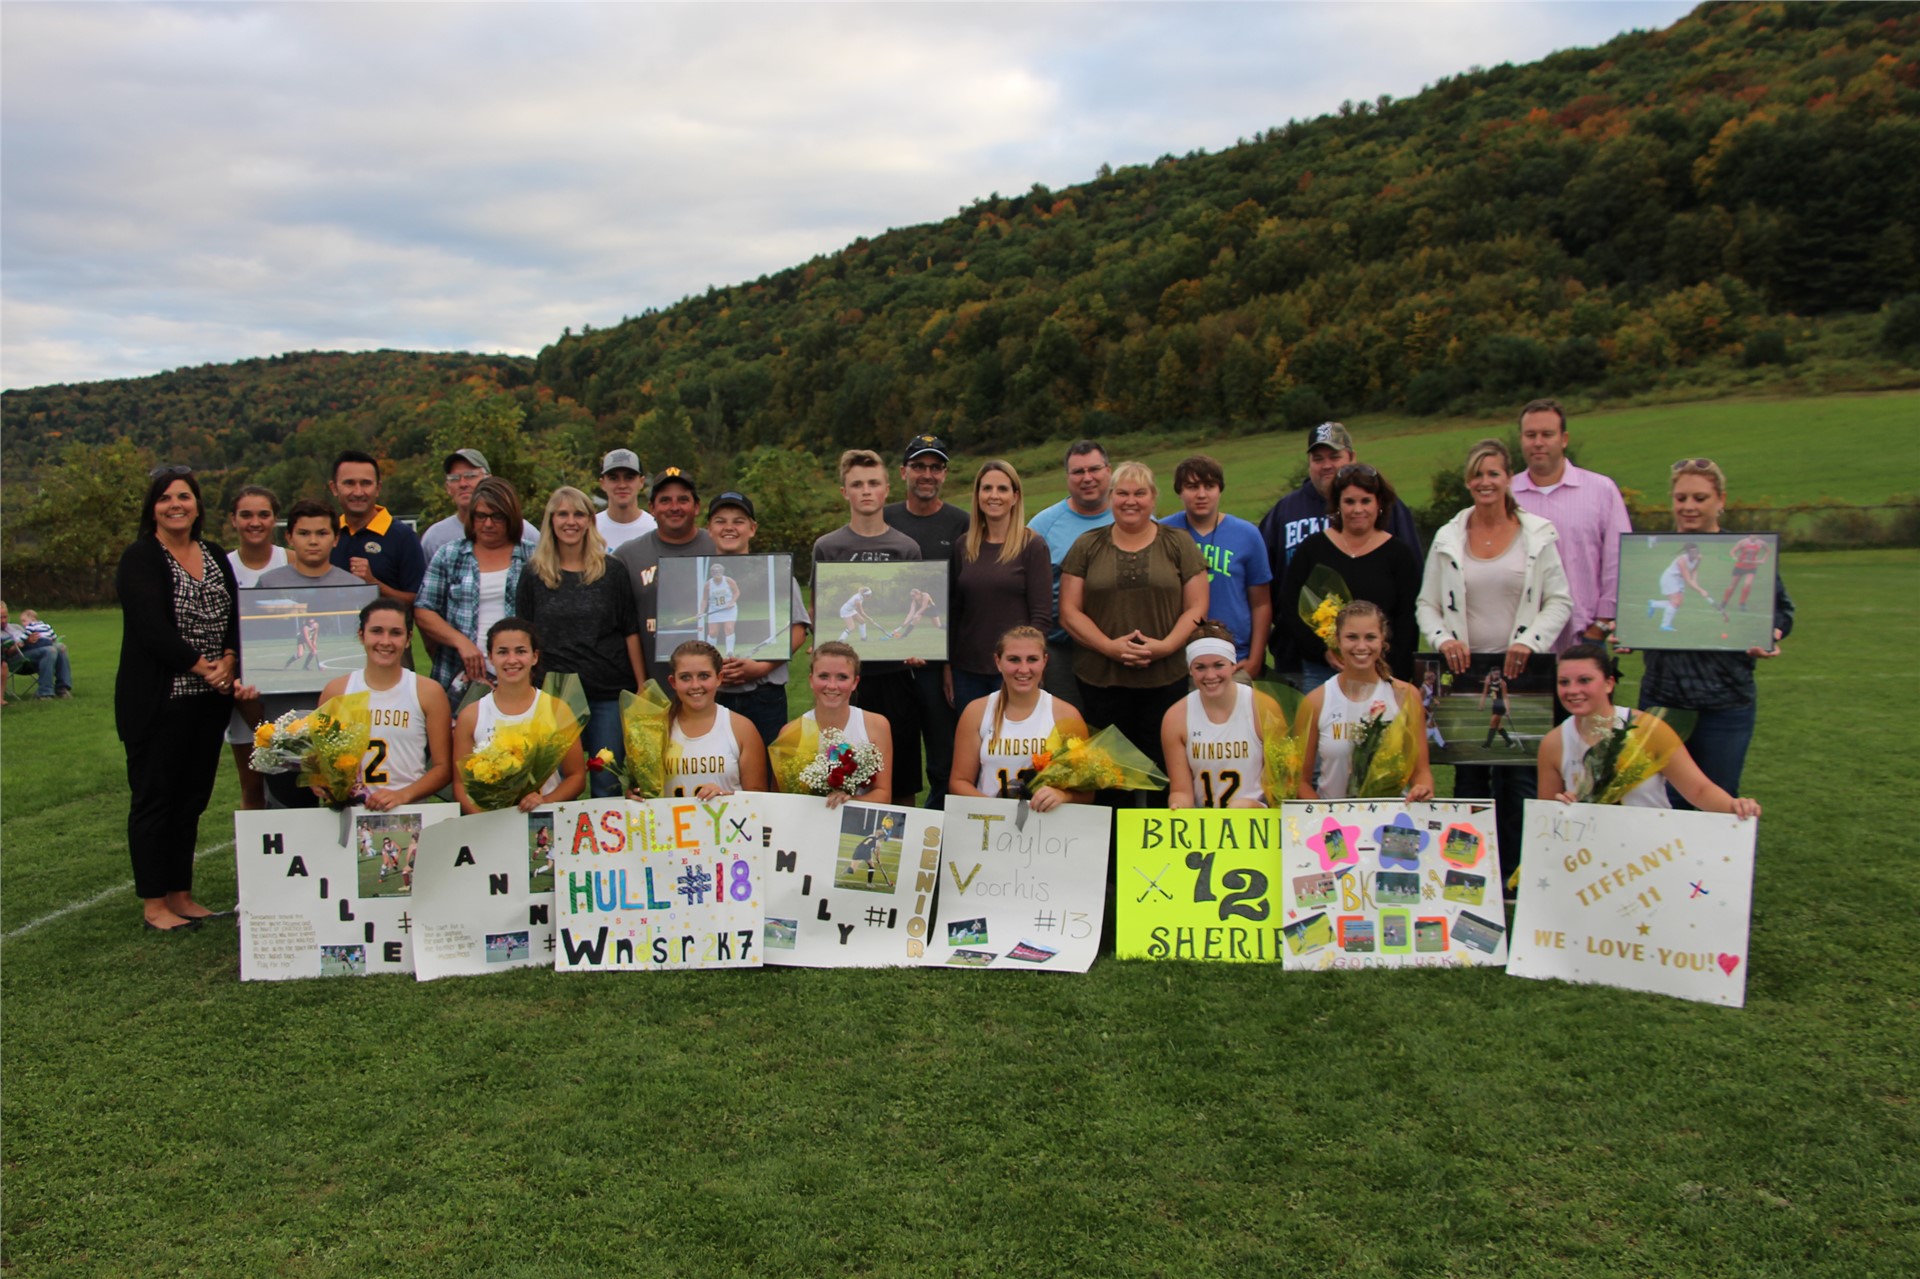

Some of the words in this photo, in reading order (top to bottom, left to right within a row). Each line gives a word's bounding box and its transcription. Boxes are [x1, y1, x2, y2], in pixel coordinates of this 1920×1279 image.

[665, 466, 681, 477] W
[1285, 517, 1330, 549] ECK
[664, 755, 725, 776] WINDSOR
[988, 738, 1047, 756] WINDSOR
[1192, 740, 1249, 760] WINDSOR
[1200, 770, 1241, 808] 12
[571, 802, 728, 855] ASHLEY
[968, 813, 1079, 868] Taylor
[1141, 818, 1281, 850] BRIAN
[1563, 848, 1593, 874] GO
[1575, 839, 1687, 906] TIFFANY!
[569, 866, 671, 914] HULL
[677, 860, 752, 905] #18
[907, 826, 941, 959] SENIOR
[949, 861, 1049, 902] Voorhis
[1186, 851, 1270, 921] 12
[1341, 870, 1379, 911] BK
[1034, 909, 1092, 939] #13
[561, 925, 694, 965] Windsor
[1534, 929, 1566, 949] WE
[1586, 935, 1645, 962] LOVE
[1657, 946, 1715, 972] YOU!
